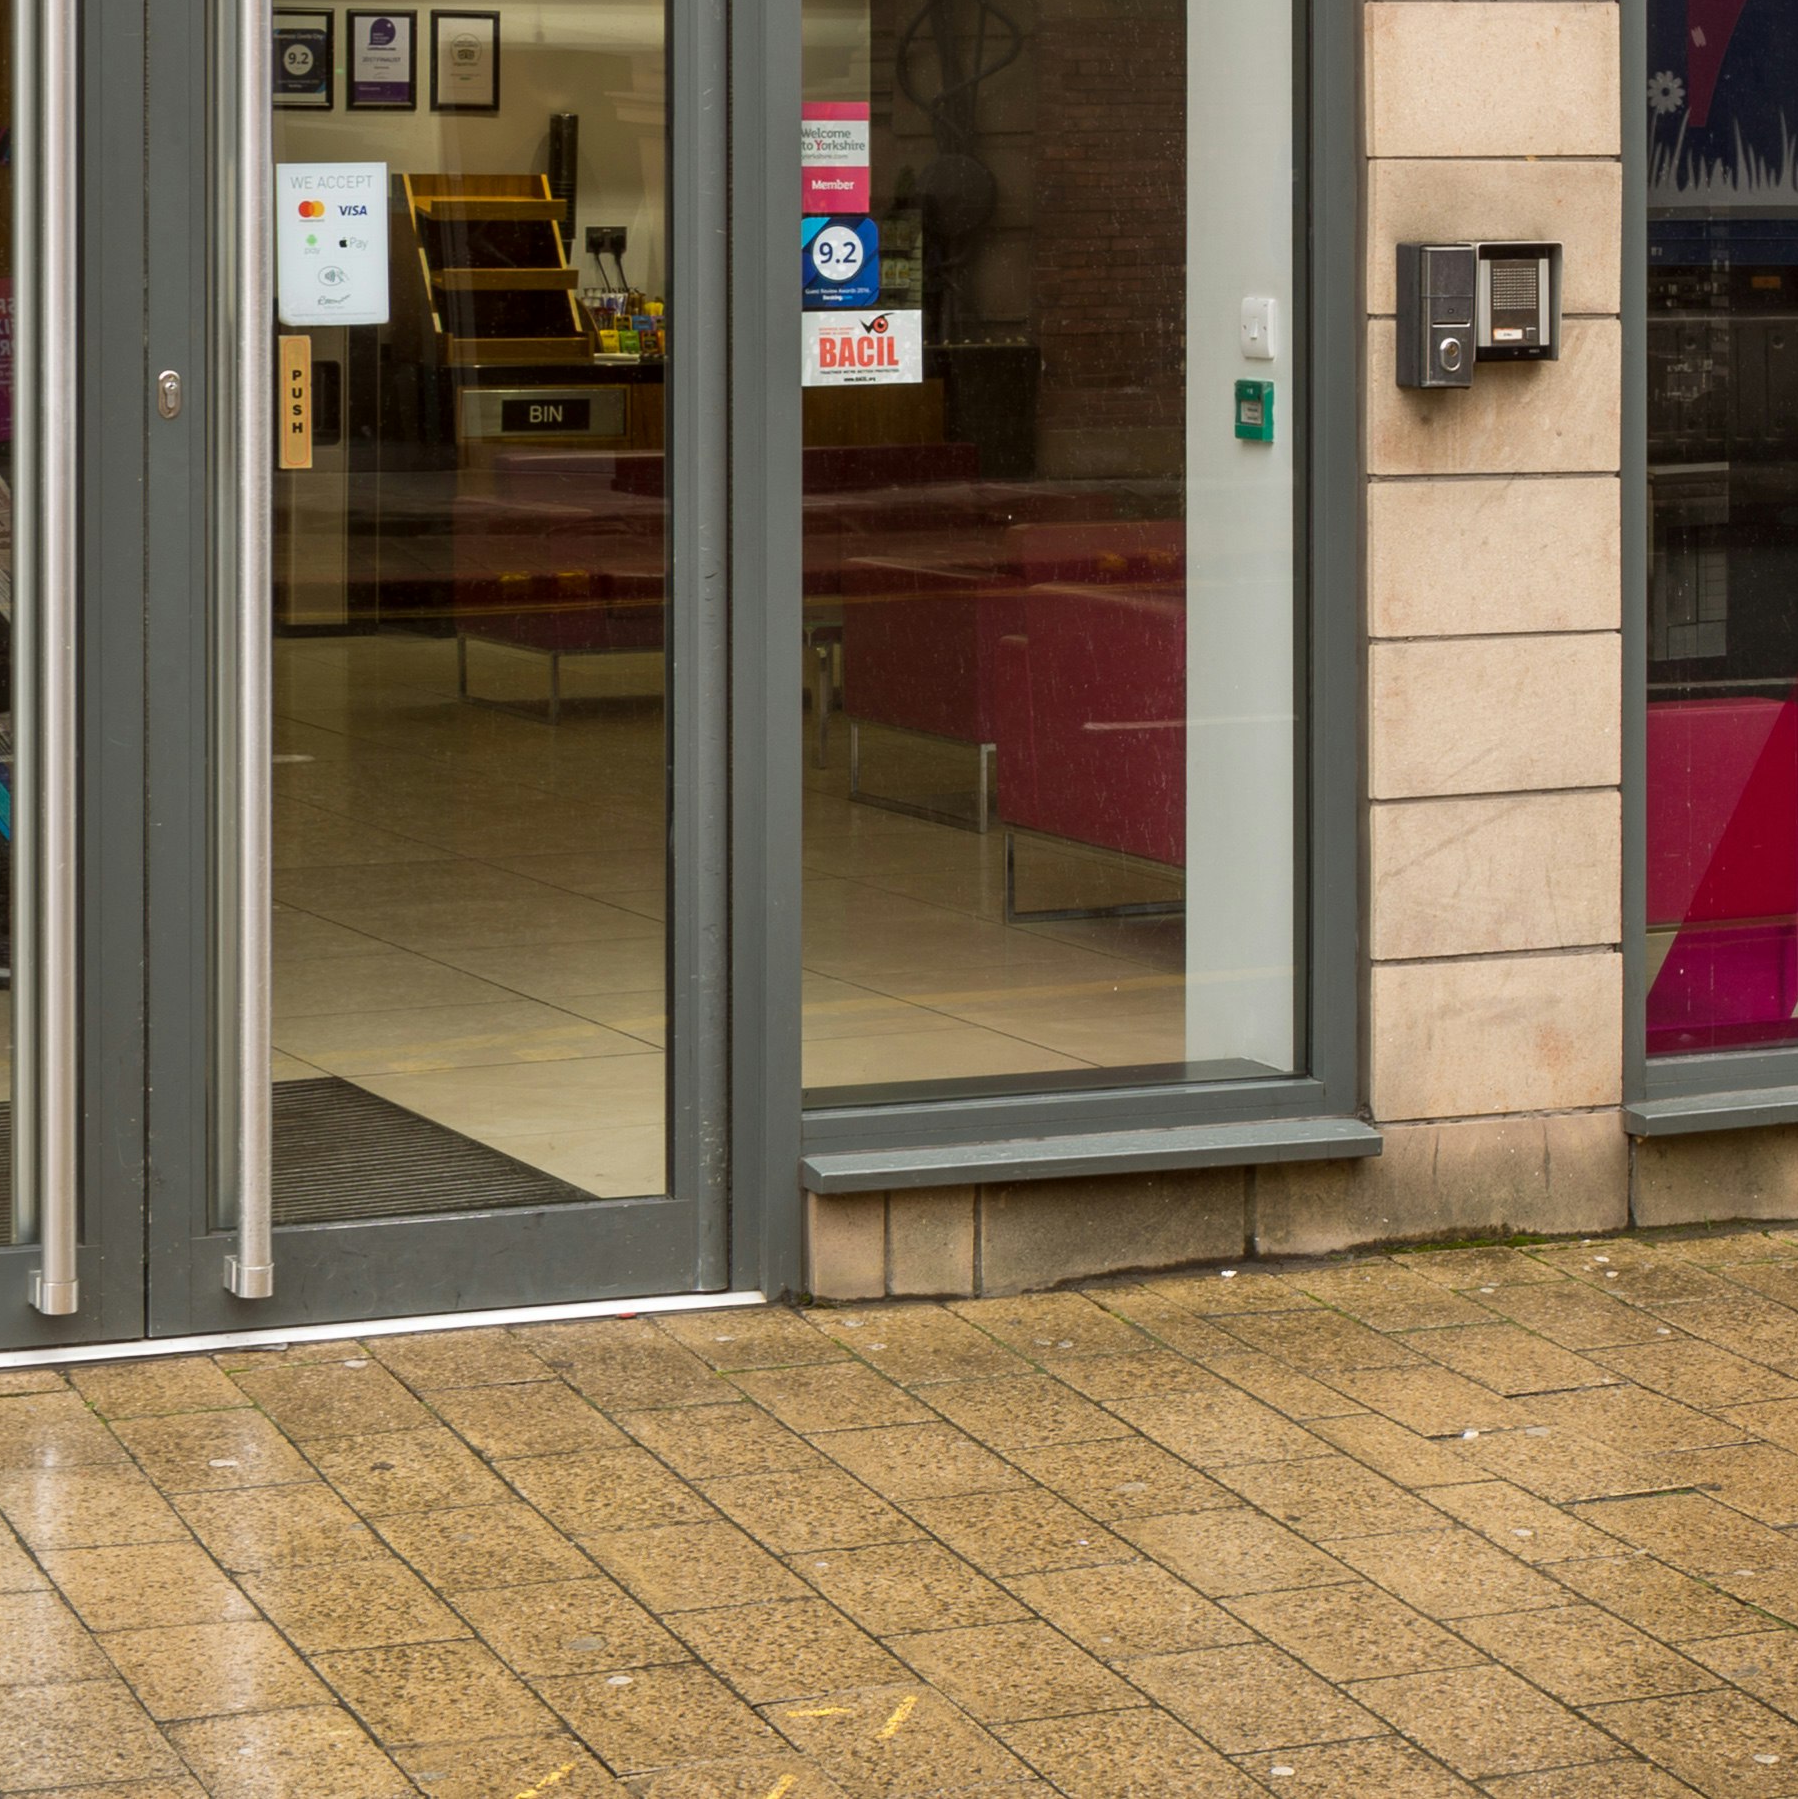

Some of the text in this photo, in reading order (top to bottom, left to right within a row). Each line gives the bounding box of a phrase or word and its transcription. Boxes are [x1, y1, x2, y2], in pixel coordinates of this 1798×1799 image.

[288, 51, 310, 66] 9.2
[801, 128, 851, 139] Welcome
[802, 140, 865, 151] to Yorkshire
[290, 175, 374, 190] WE ACCEPT
[811, 179, 855, 190] Member
[338, 205, 368, 216] VISA
[350, 237, 369, 251] Pay
[819, 241, 857, 264] 9.2
[819, 336, 899, 368] BACIL
[291, 370, 303, 433] PUSH
[529, 405, 563, 422] BIN
